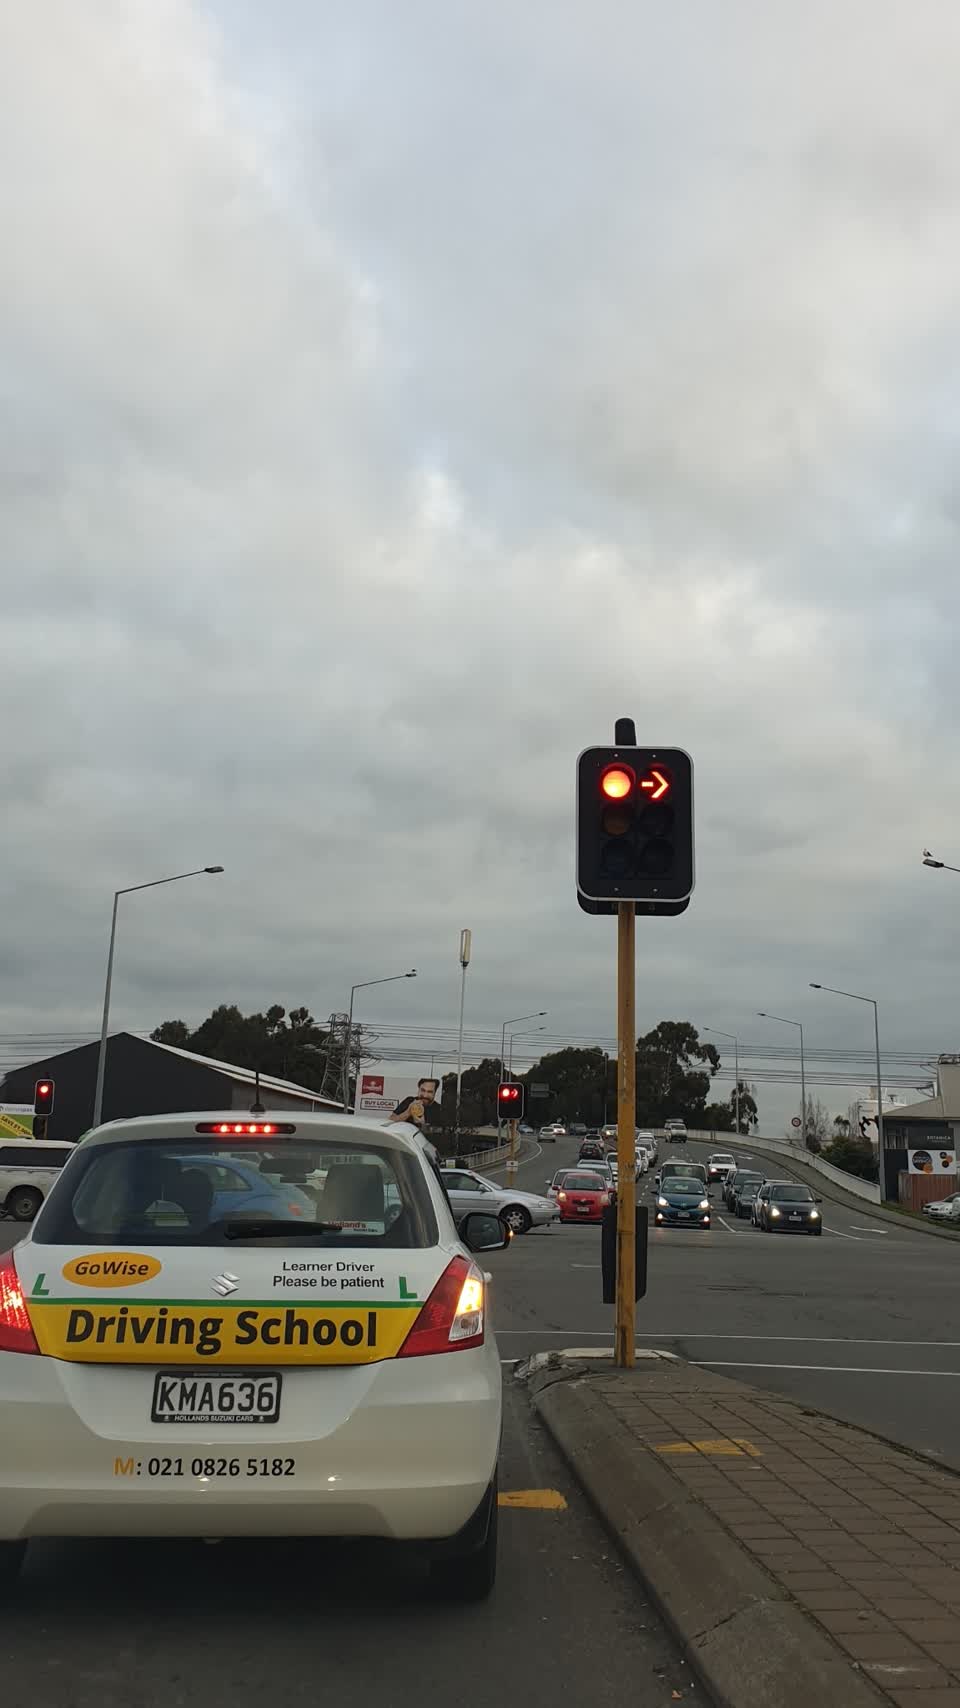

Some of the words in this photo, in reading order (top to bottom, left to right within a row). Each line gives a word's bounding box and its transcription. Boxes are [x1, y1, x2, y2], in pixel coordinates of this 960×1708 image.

[74, 1261, 149, 1275] GoWise
[282, 1261, 333, 1271] Learner
[336, 1262, 375, 1272] Driver
[32, 1273, 50, 1295] L
[273, 1275, 317, 1287] Please
[321, 1275, 338, 1287] be
[340, 1276, 385, 1290] patient
[398, 1276, 418, 1299] L
[66, 1306, 223, 1356] Driving
[234, 1309, 377, 1347] School
[158, 1382, 274, 1412] KMA636
[148, 1458, 184, 1476] 021
[191, 1458, 240, 1476] 0826
[246, 1458, 296, 1477] 5182
